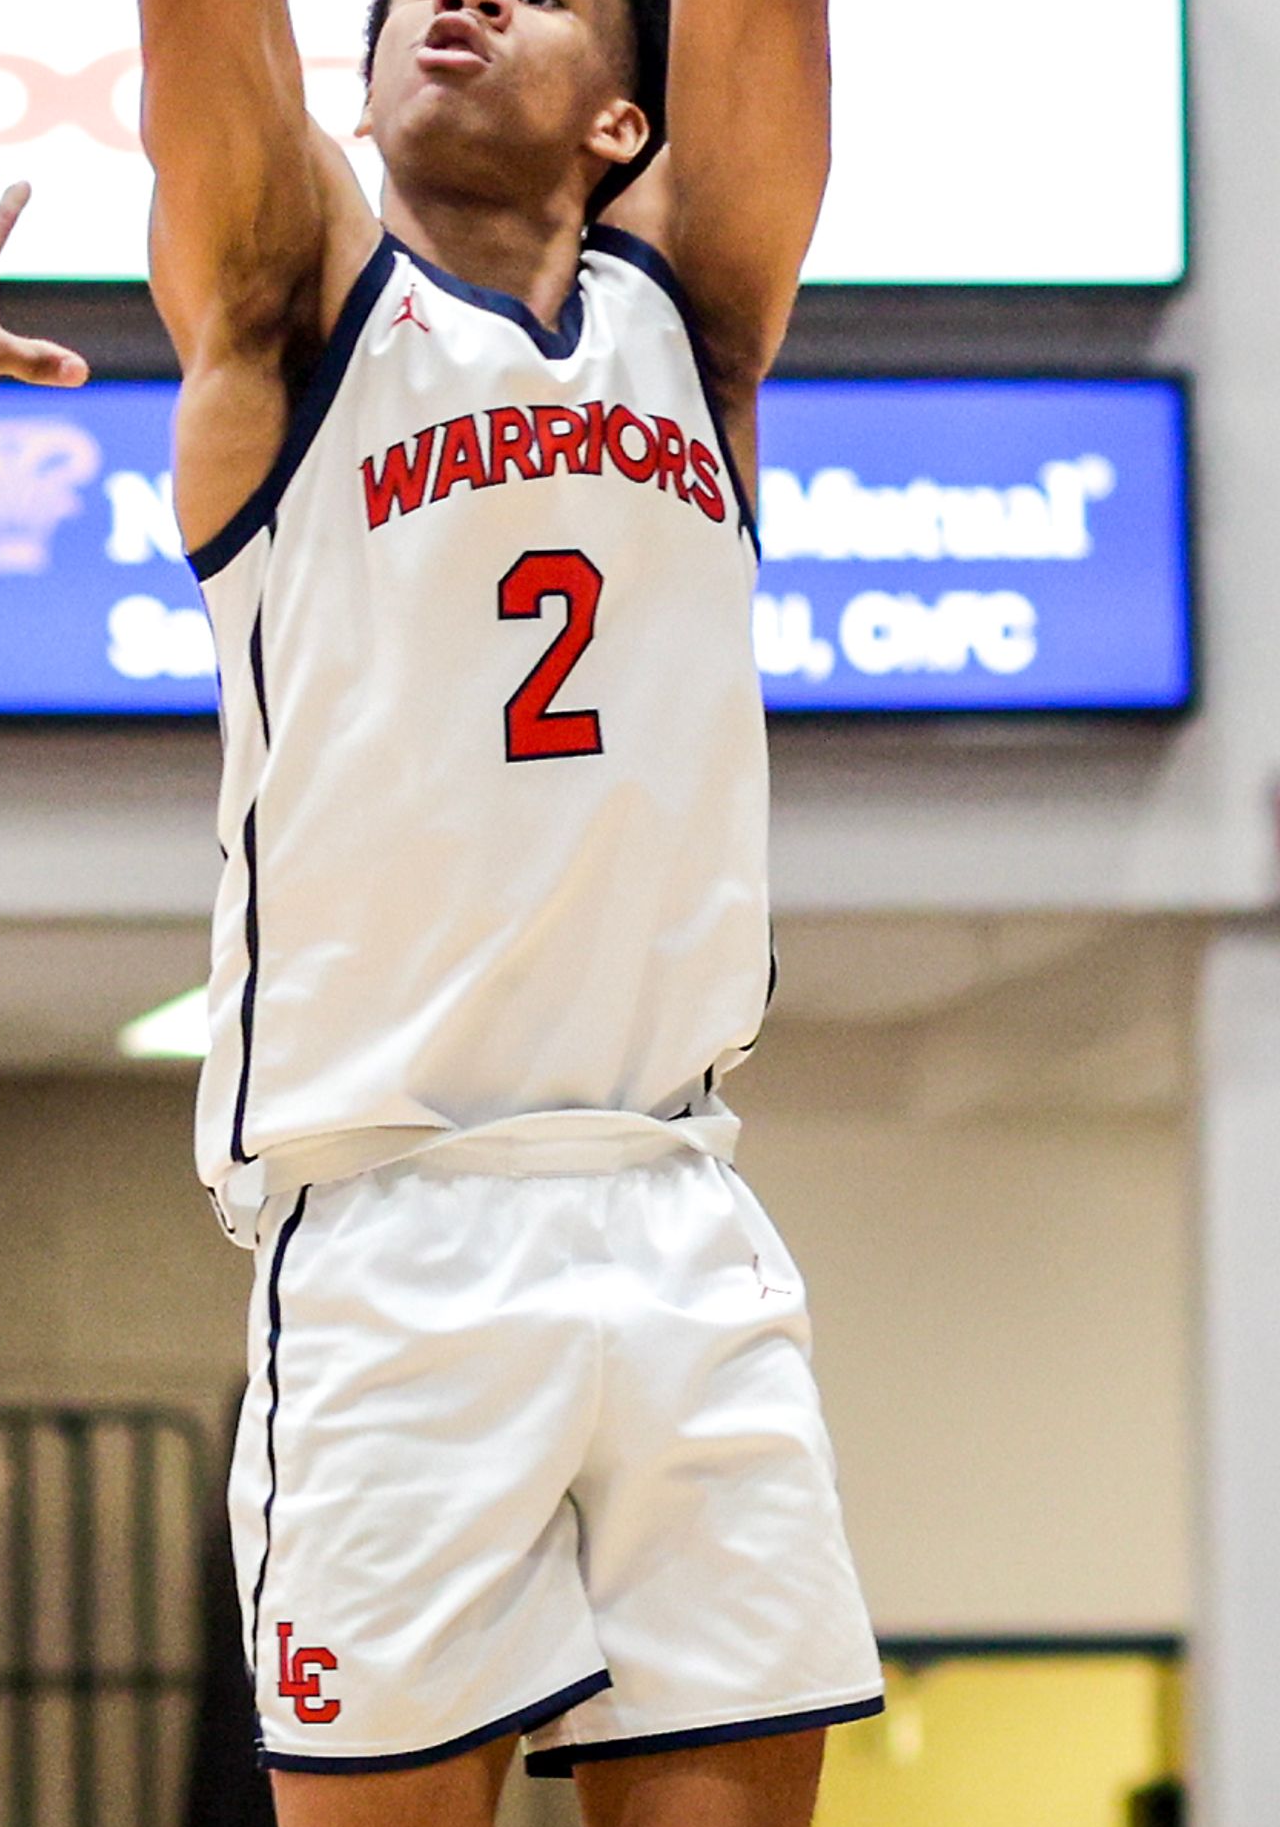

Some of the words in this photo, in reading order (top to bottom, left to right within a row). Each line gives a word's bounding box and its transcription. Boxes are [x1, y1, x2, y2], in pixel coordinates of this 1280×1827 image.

[358, 399, 727, 533] WARRIORS
[496, 548, 606, 765] 2
[276, 1621, 342, 1725] LC
